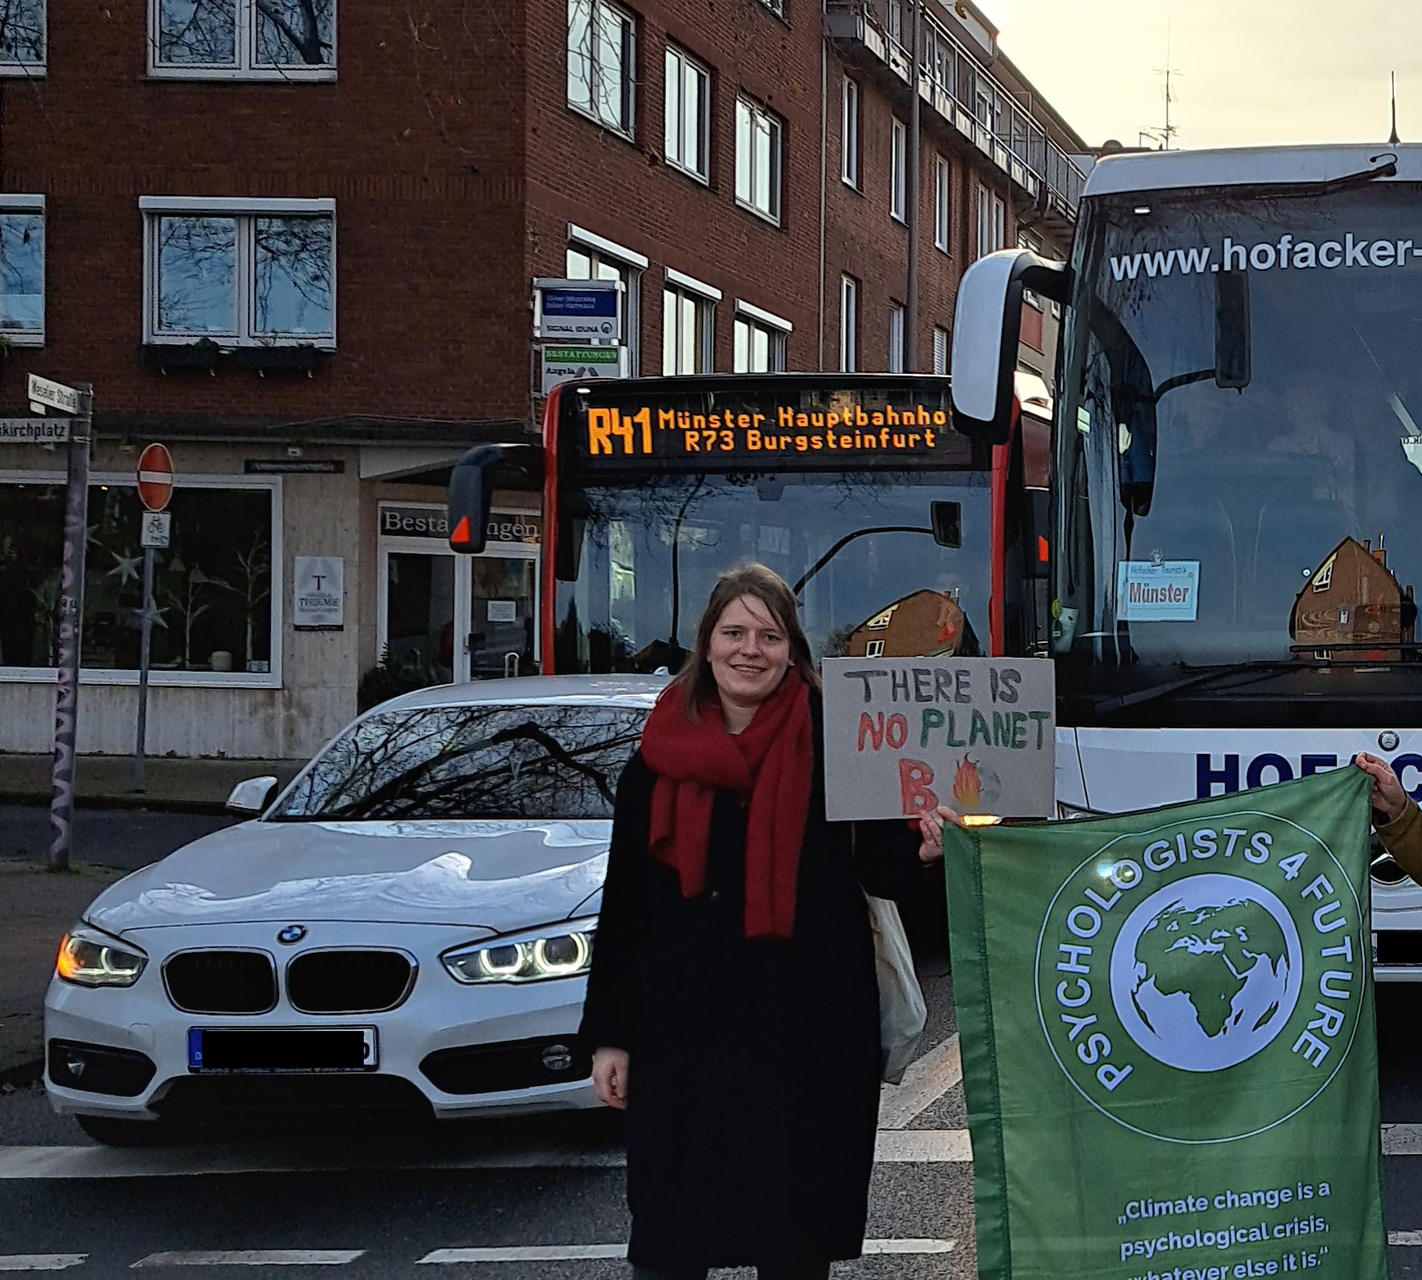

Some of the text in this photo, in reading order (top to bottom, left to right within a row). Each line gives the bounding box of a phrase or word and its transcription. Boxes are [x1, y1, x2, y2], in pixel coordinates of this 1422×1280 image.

[545, 350, 617, 359] BESTATTUNGEN
[0, 422, 66, 439] kirchplatz
[588, 407, 653, 455] R41
[658, 404, 953, 430] Münster Hauptbahnho
[685, 428, 936, 452] R73 Burgsteinfurt
[384, 511, 538, 541] Bestangen
[312, 575, 326, 590] T
[1129, 583, 1189, 603] Münster
[844, 668, 1021, 703] THERE IS
[858, 708, 1050, 752] NO PLANET
[898, 758, 938, 815] B
[1056, 828, 1353, 1092] PSYCHOLOGISTS 4 FUTURE
[1213, 1186, 1293, 1209] change
[1297, 1181, 1314, 1201] is
[1317, 1182, 1331, 1197] a
[1120, 1214, 1330, 1262] psychological crisis,
[1128, 1264, 1230, 1280] hatever
[1233, 1258, 1279, 1279] else
[1281, 1253, 1298, 1273] it
